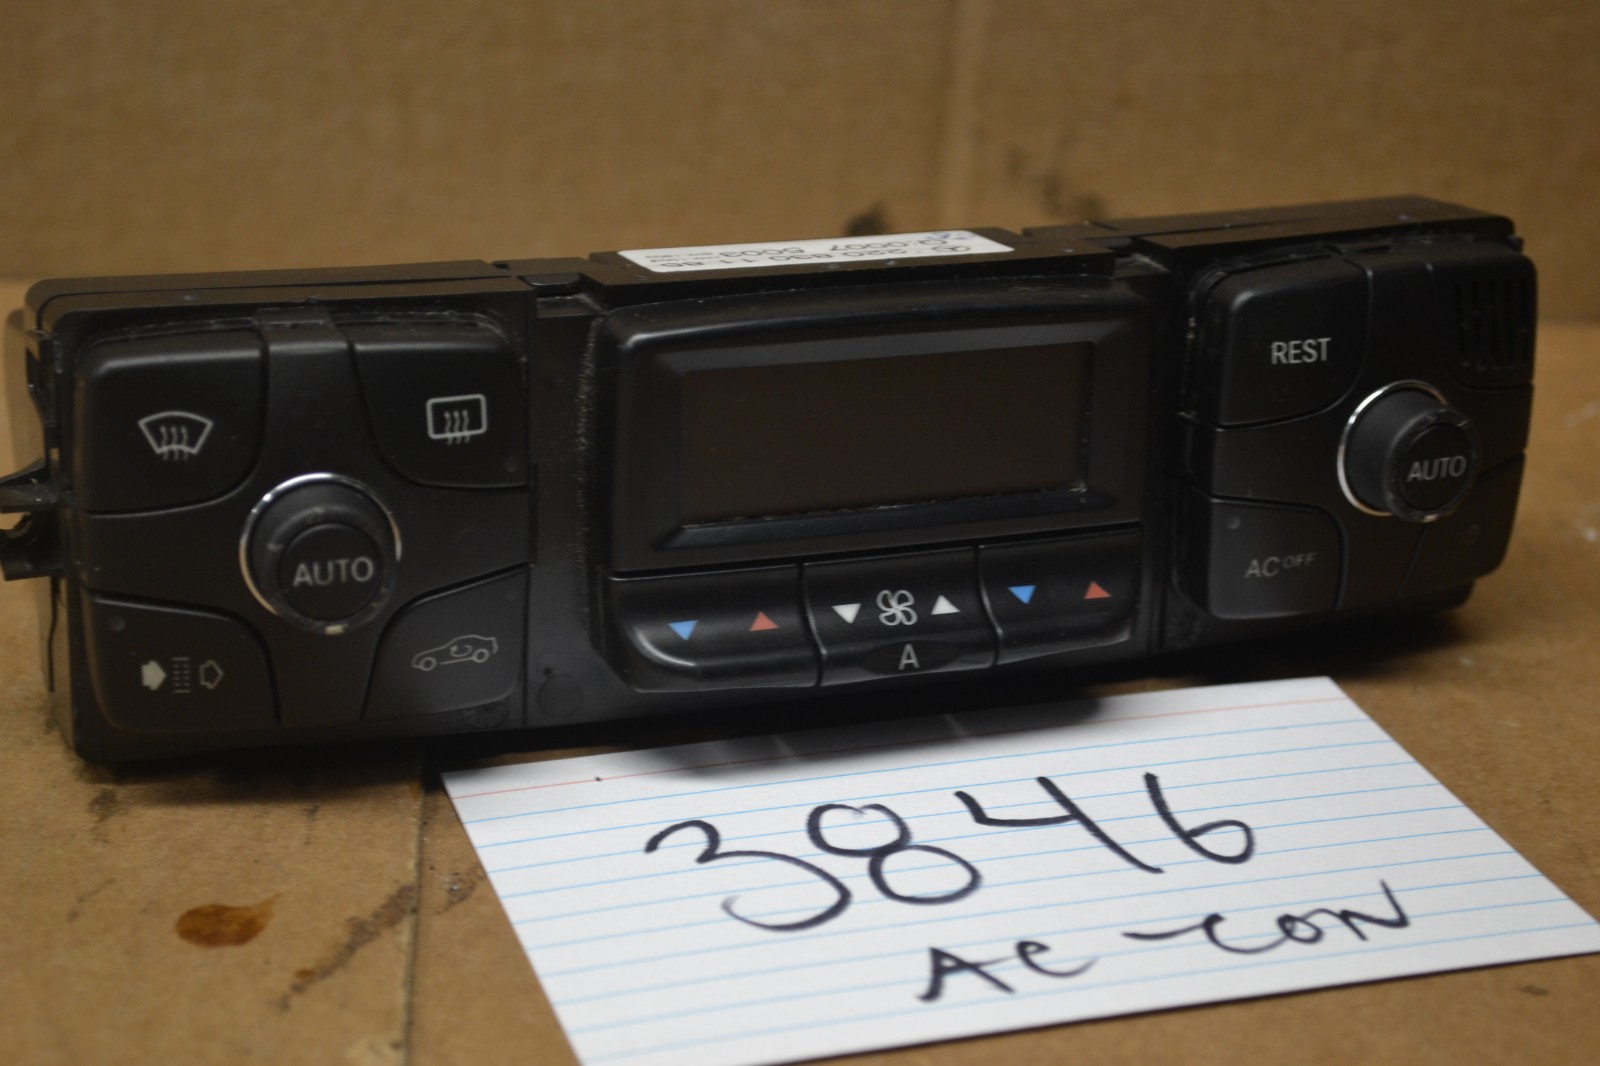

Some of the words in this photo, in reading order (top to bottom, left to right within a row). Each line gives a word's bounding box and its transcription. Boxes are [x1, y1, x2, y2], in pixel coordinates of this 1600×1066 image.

[1270, 337, 1332, 365] REST
[1406, 454, 1467, 483] AUTO
[292, 555, 376, 589] AUTO
[897, 643, 921, 671] A
[643, 771, 1256, 933] 3846
